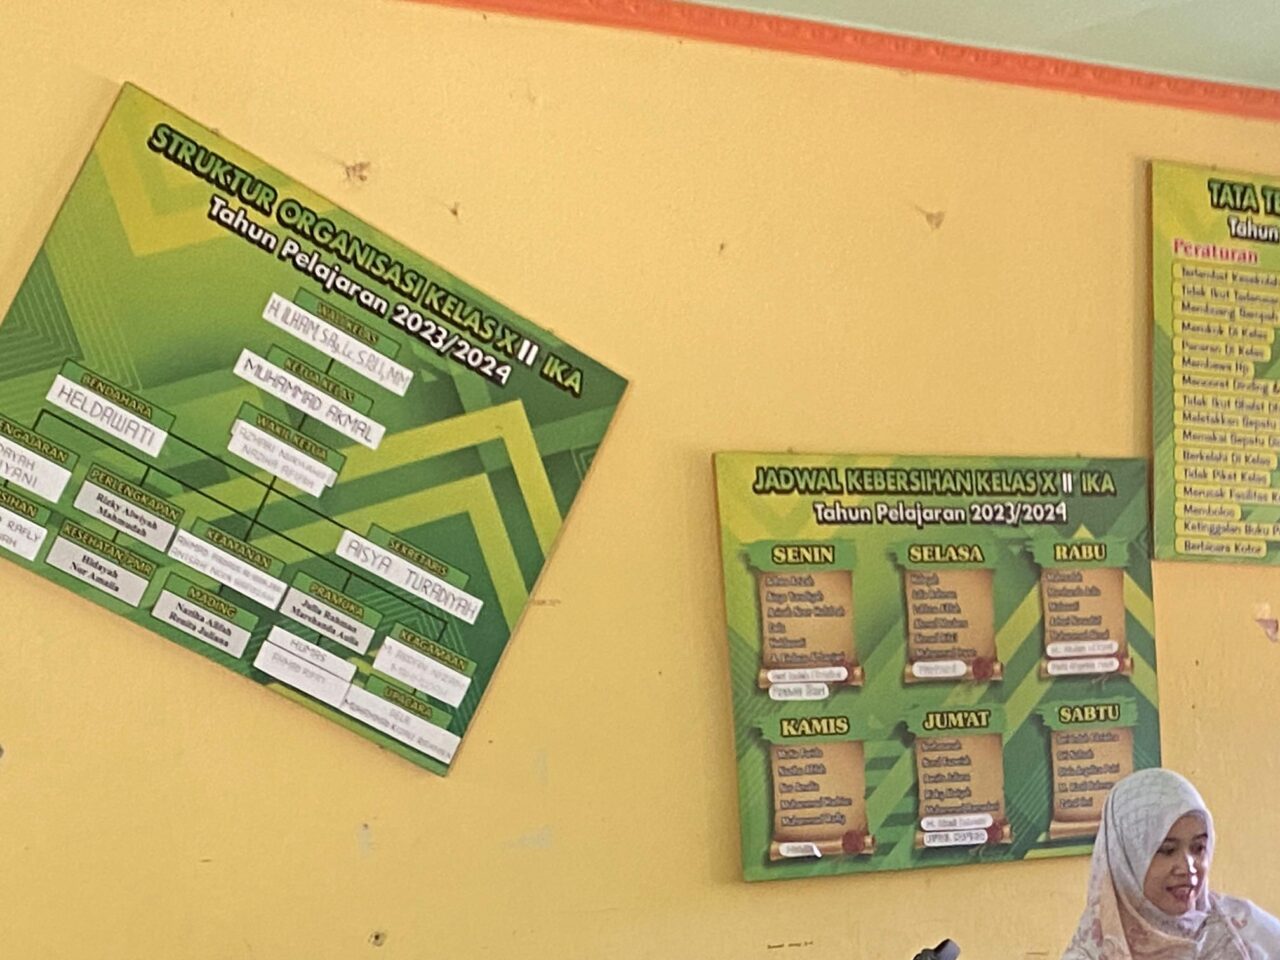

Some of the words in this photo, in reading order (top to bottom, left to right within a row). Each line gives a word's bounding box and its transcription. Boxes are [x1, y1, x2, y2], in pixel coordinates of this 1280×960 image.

[1208, 179, 1259, 213] TATA
[1228, 215, 1279, 243] Tahun
[149, 124, 276, 215] STRUKTUR
[278, 200, 425, 299] ORGANISASI
[423, 281, 497, 341] KELAS
[542, 354, 583, 396] IKA
[1173, 239, 1258, 263] Peraturan
[209, 195, 277, 255] Tahun
[280, 238, 389, 318] Pelajaran
[390, 305, 512, 387] 2023/2024
[1182, 285, 1206, 296] Tidak
[81, 374, 152, 419] BENDAHARA
[240, 357, 325, 412] MUHAMMAD
[323, 403, 378, 443] AKMAL
[1183, 395, 1207, 407] Tidak
[57, 384, 156, 447] HELDAWATI
[753, 466, 842, 494] JADWAL
[846, 468, 973, 495] KEBERSIHAN
[975, 468, 1039, 496] KELAS
[1080, 470, 1116, 496] IKA
[1184, 468, 1208, 480] Tidak
[1241, 472, 1266, 484] Kelas
[89, 468, 180, 521] PERLENGKAPAN
[813, 501, 872, 524] Tahun
[876, 500, 966, 529] Pelajaran
[969, 501, 1068, 527] 2023/2024
[205, 528, 272, 570] KEAMANAN
[345, 539, 392, 572] AISYA
[388, 537, 448, 577] SEKRETARIS
[772, 545, 835, 564] SENIN
[908, 544, 984, 563] SELASA
[1054, 543, 1107, 563] RABU
[187, 586, 237, 619] MADING
[309, 581, 364, 619] PRAMUKA
[400, 627, 468, 670] KEAGAMAAN
[385, 686, 432, 719] UPACARA
[1059, 703, 1120, 723] SABTU
[781, 716, 850, 737] KAMIS
[923, 709, 991, 730] JUM'AT
